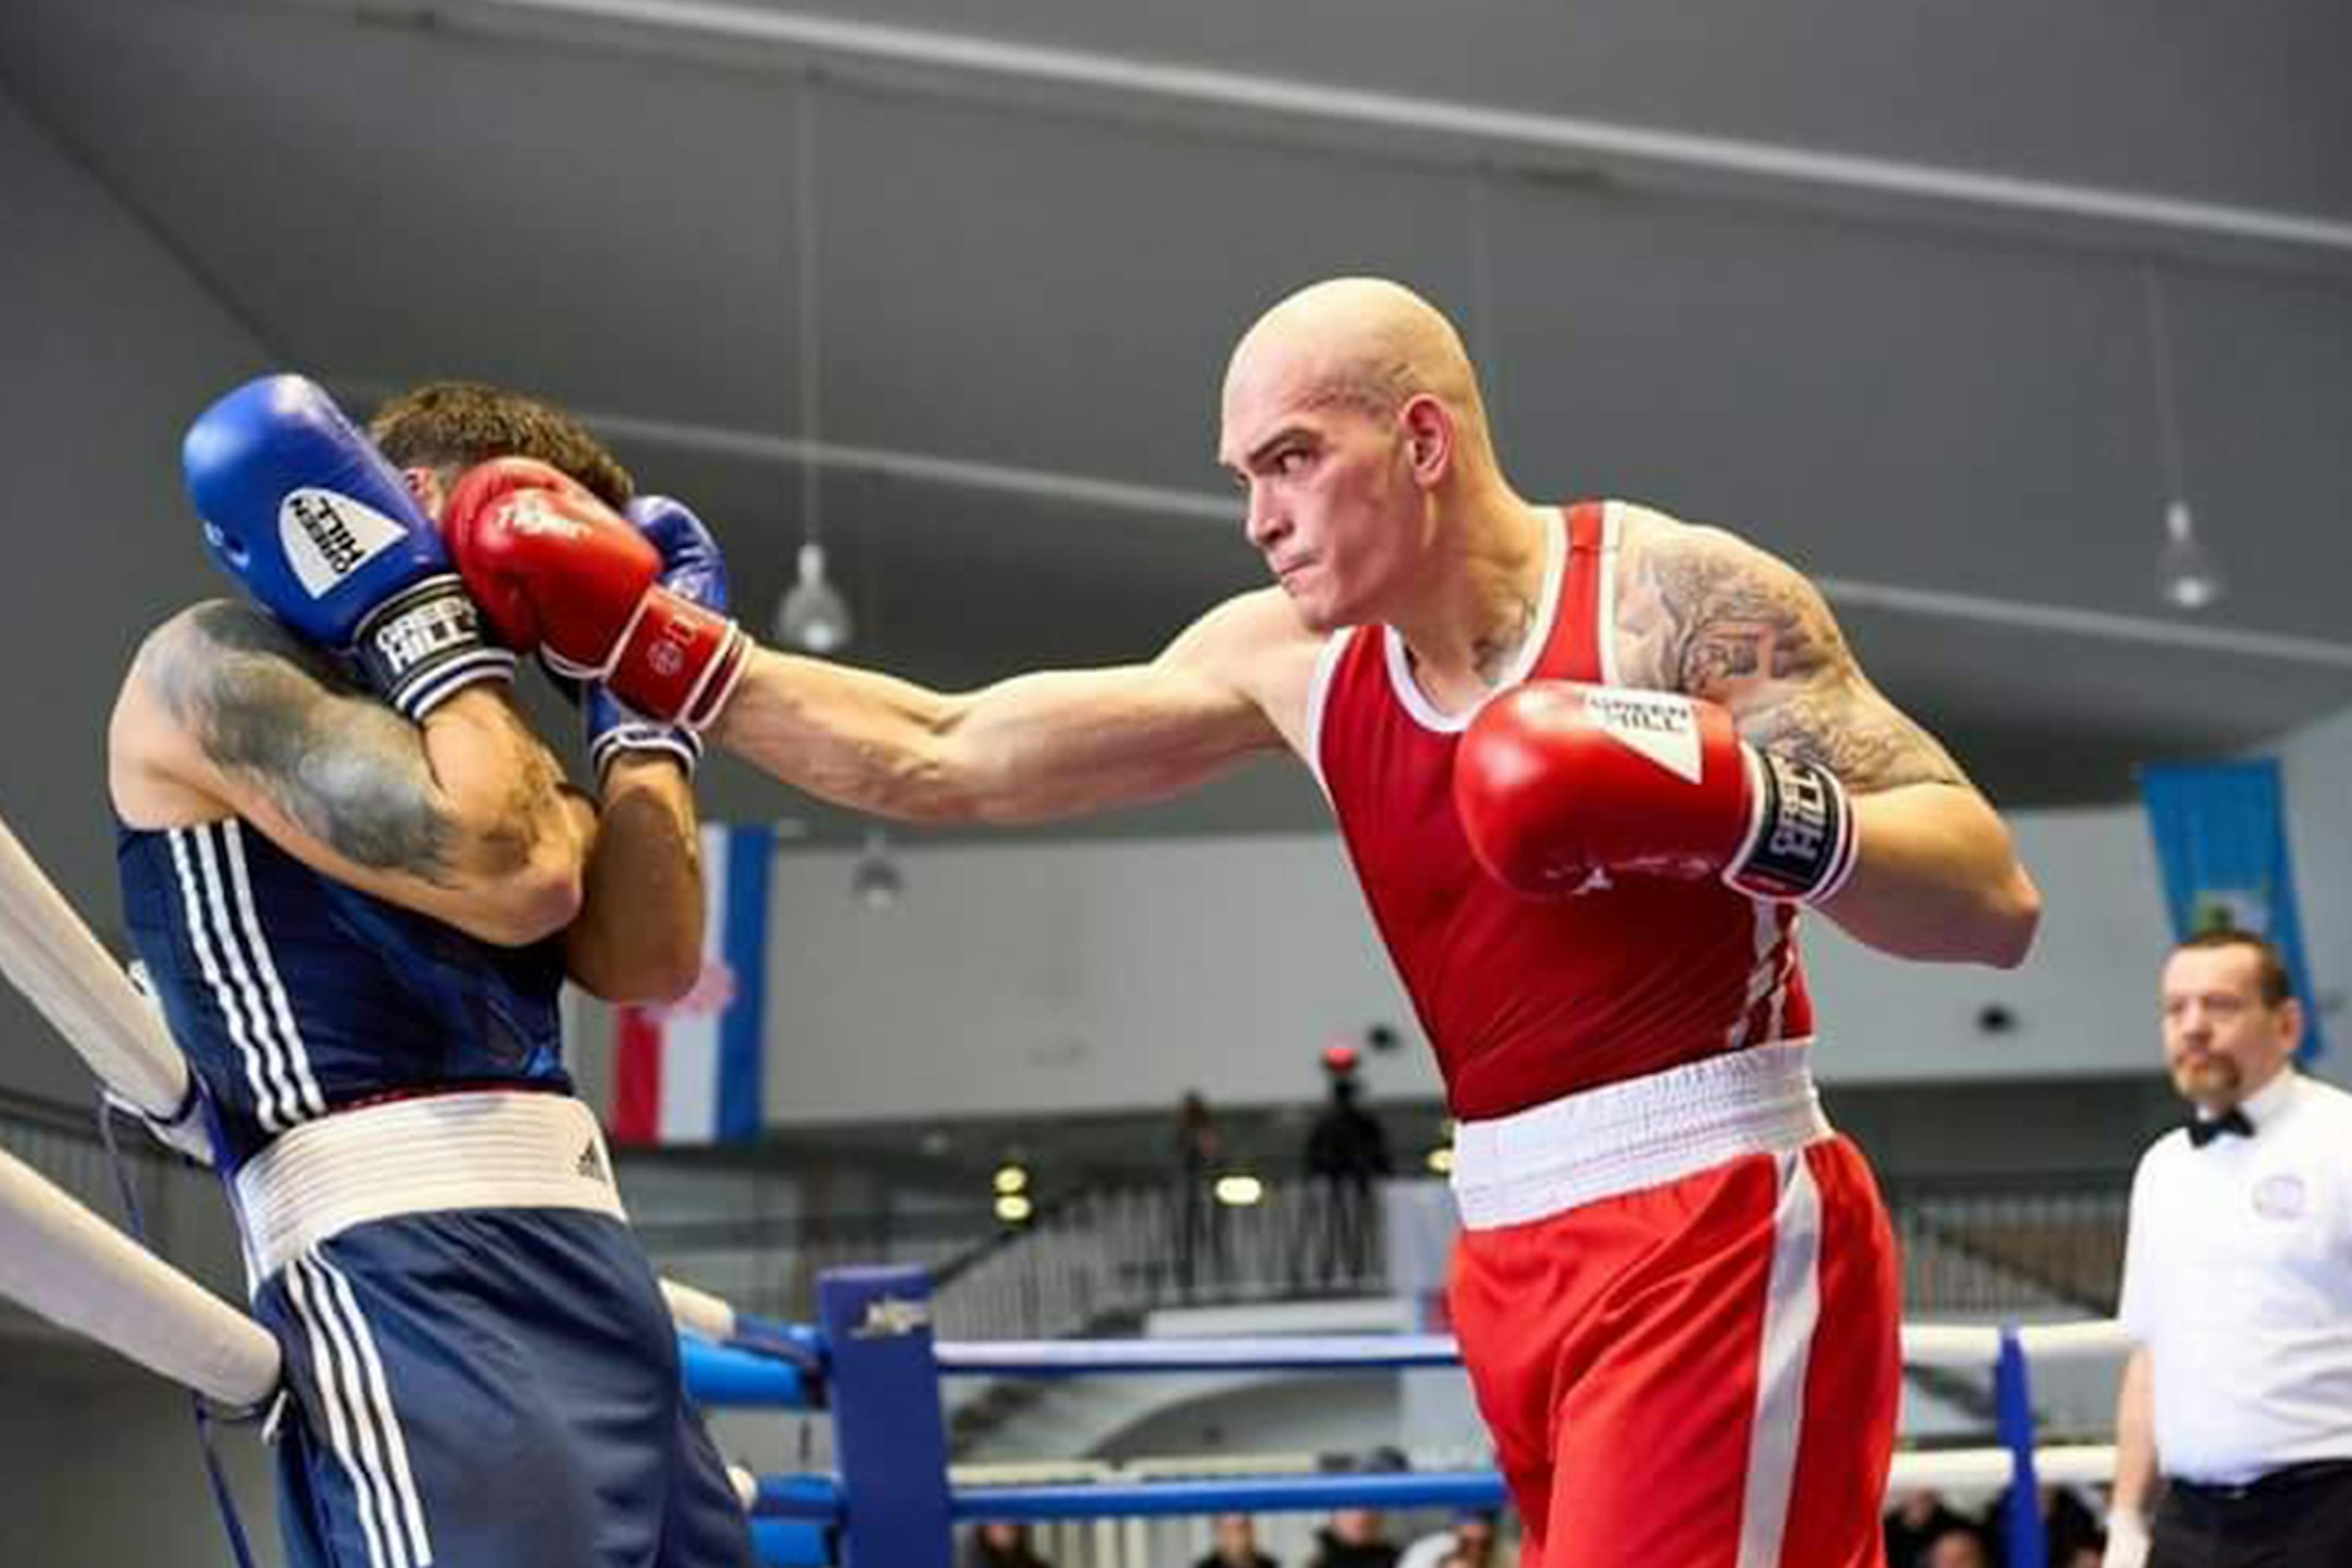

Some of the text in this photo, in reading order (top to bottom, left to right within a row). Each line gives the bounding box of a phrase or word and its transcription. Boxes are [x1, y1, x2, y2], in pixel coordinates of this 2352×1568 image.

[288, 497, 349, 573] GREEN
[317, 496, 365, 562] HILL
[385, 617, 477, 673] HILL
[1787, 769, 1826, 859] HILL
